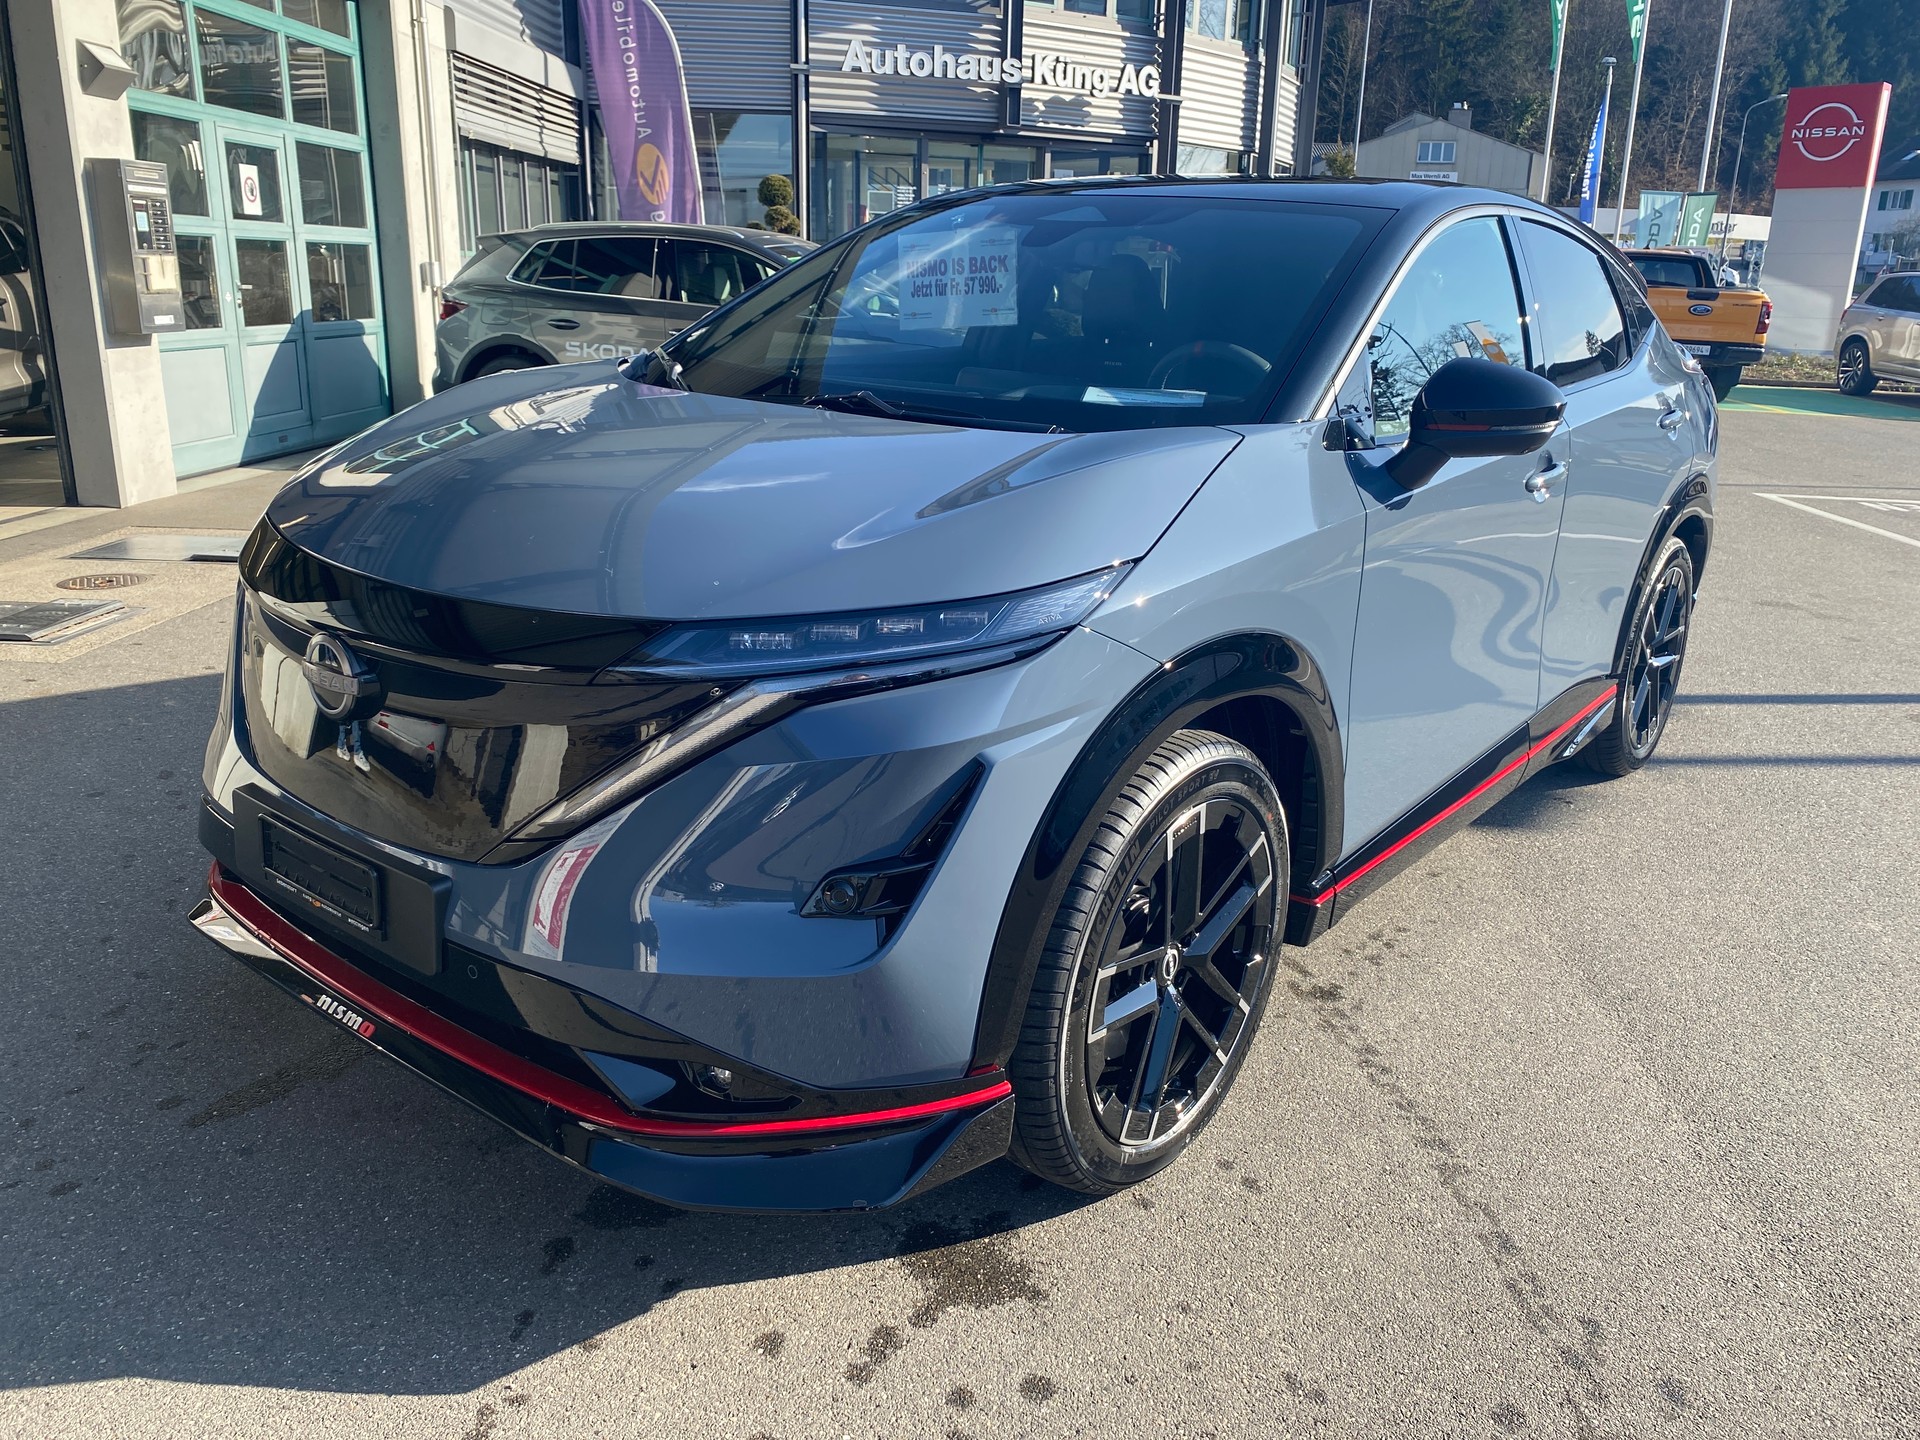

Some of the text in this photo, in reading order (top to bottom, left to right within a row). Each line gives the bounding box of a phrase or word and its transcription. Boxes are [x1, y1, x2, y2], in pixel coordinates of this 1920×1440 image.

[841, 39, 1162, 98] Autohaus Küng AG
[1791, 125, 1865, 139] NISSAN
[907, 254, 1009, 279] NISMO IS BACK
[911, 280, 933, 298] Jetzt
[935, 278, 948, 297] für
[950, 278, 962, 296] Fr.
[1038, 612, 1063, 624] ARIYA
[1083, 839, 1142, 969] MICHELIN
[1149, 802, 1177, 832] PILOT
[1178, 775, 1207, 801] SPORT
[316, 994, 376, 1038] nismo
